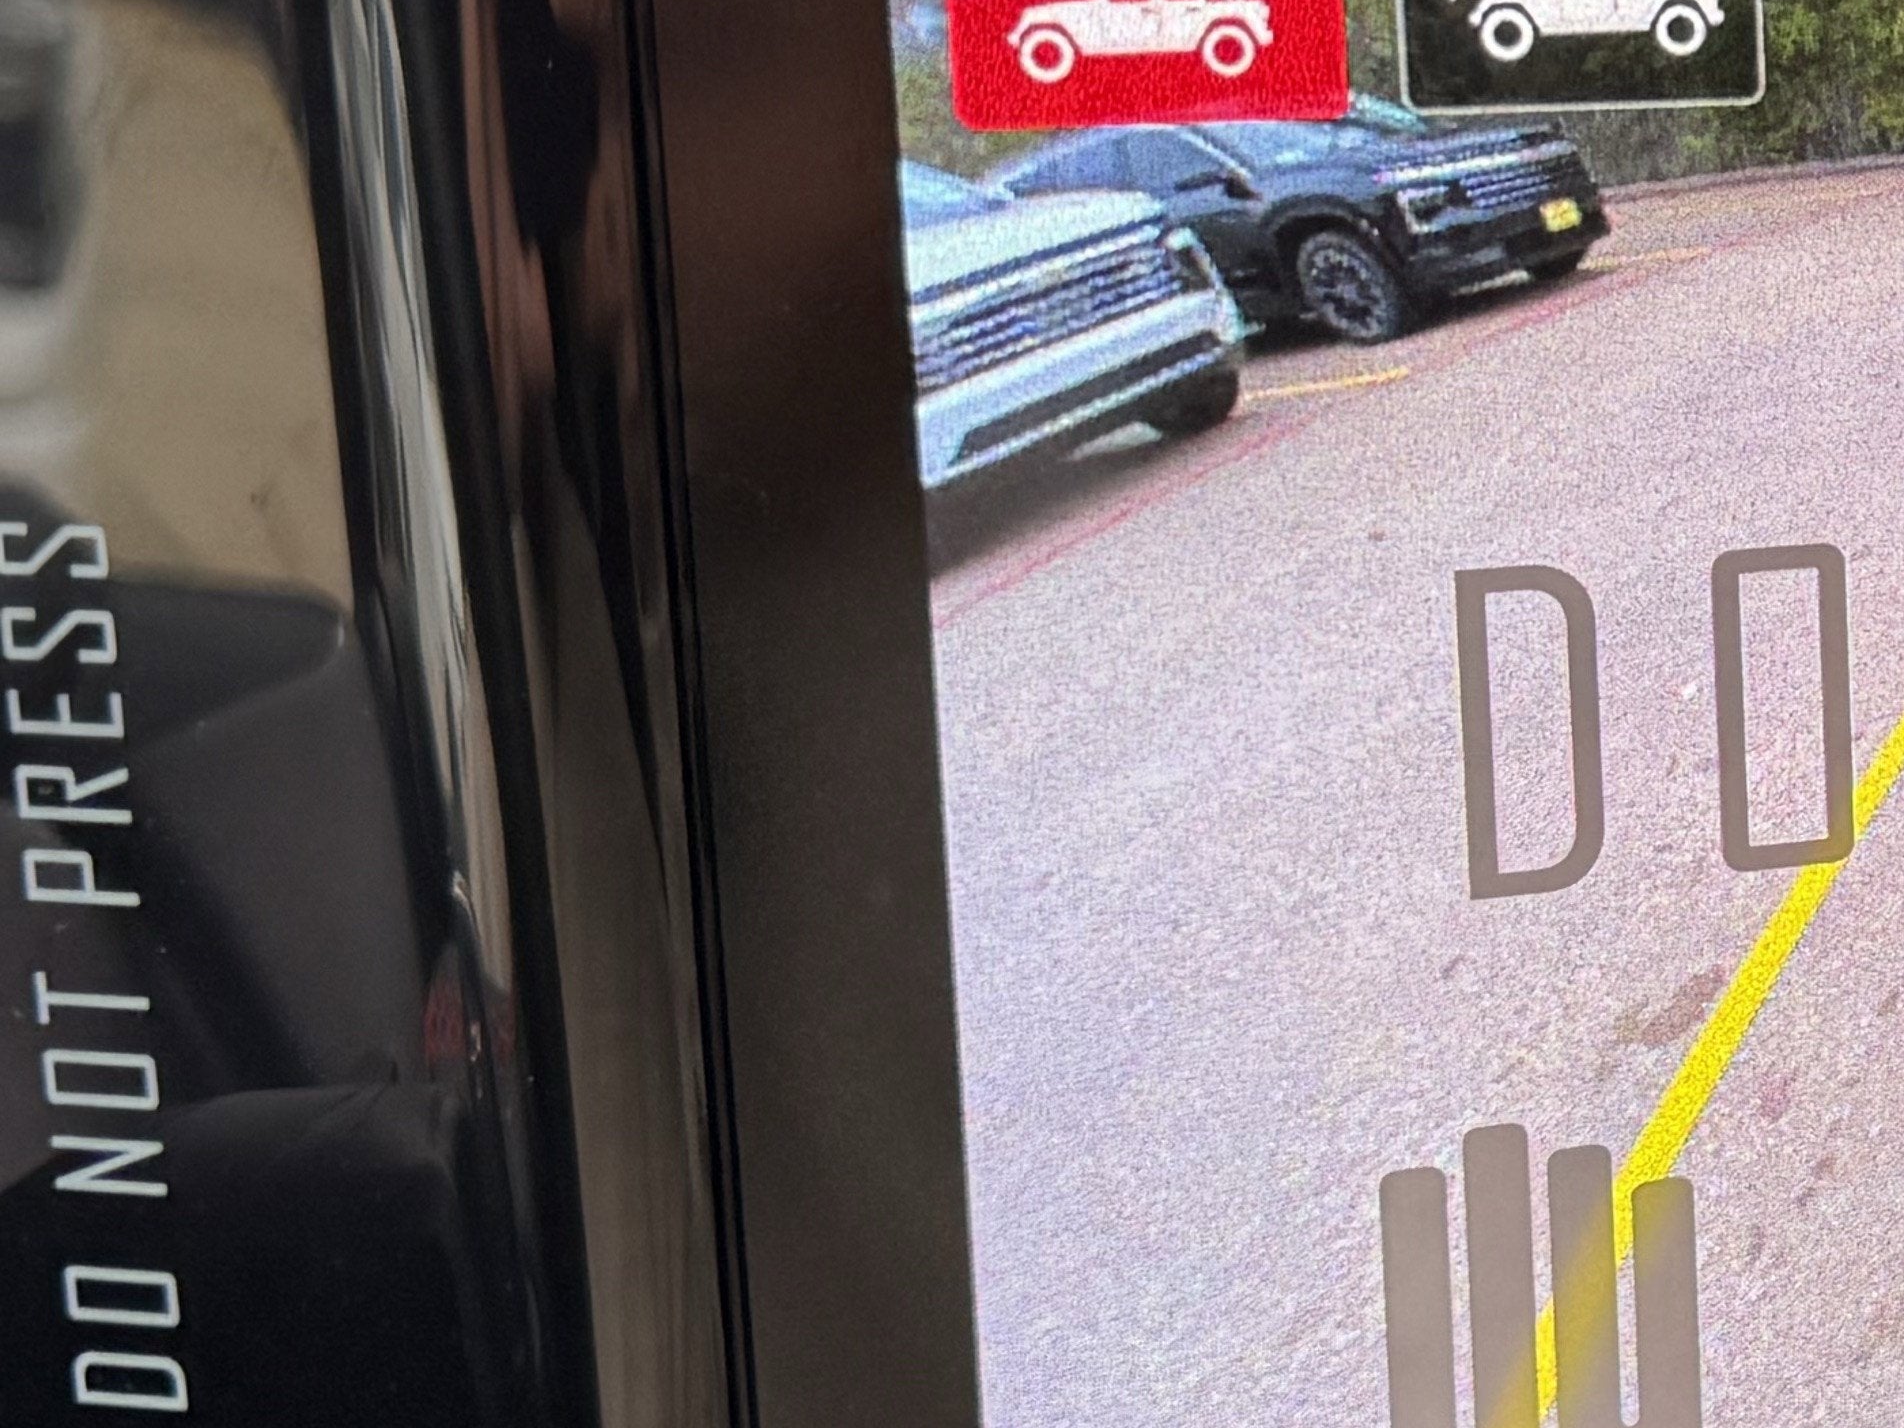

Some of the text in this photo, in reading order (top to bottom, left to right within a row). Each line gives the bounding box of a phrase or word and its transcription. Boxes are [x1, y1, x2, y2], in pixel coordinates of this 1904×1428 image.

[0, 521, 189, 1412] DO NOT PRESS
[1454, 541, 1856, 900] DO
